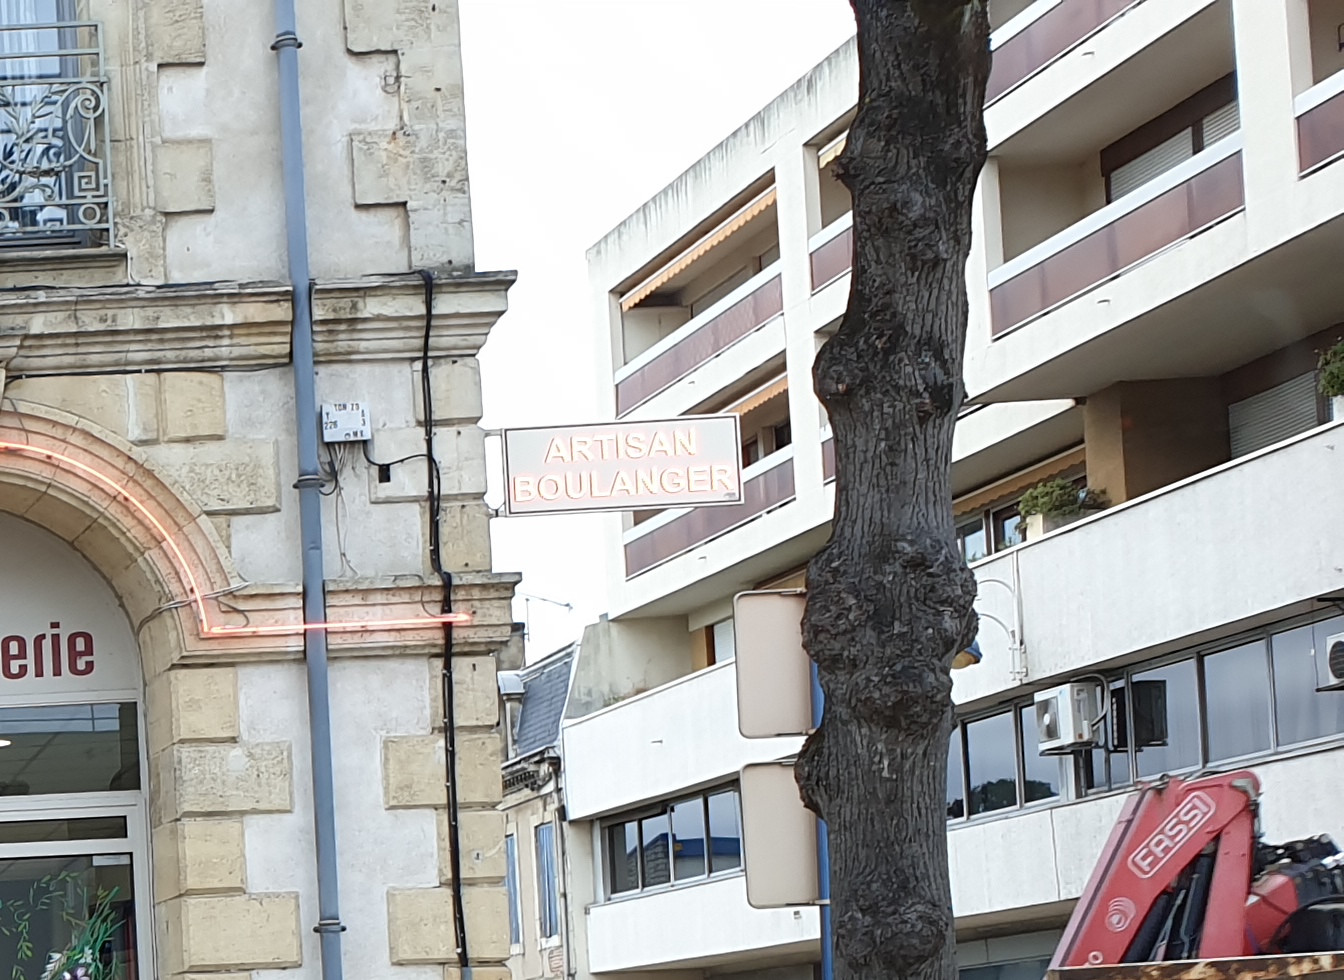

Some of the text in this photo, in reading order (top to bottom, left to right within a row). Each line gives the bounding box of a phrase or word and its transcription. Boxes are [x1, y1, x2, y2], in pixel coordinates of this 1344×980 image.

[544, 426, 698, 464] ARTISAN
[513, 464, 736, 502] BOULANGER
[1133, 797, 1210, 872] FASSI
